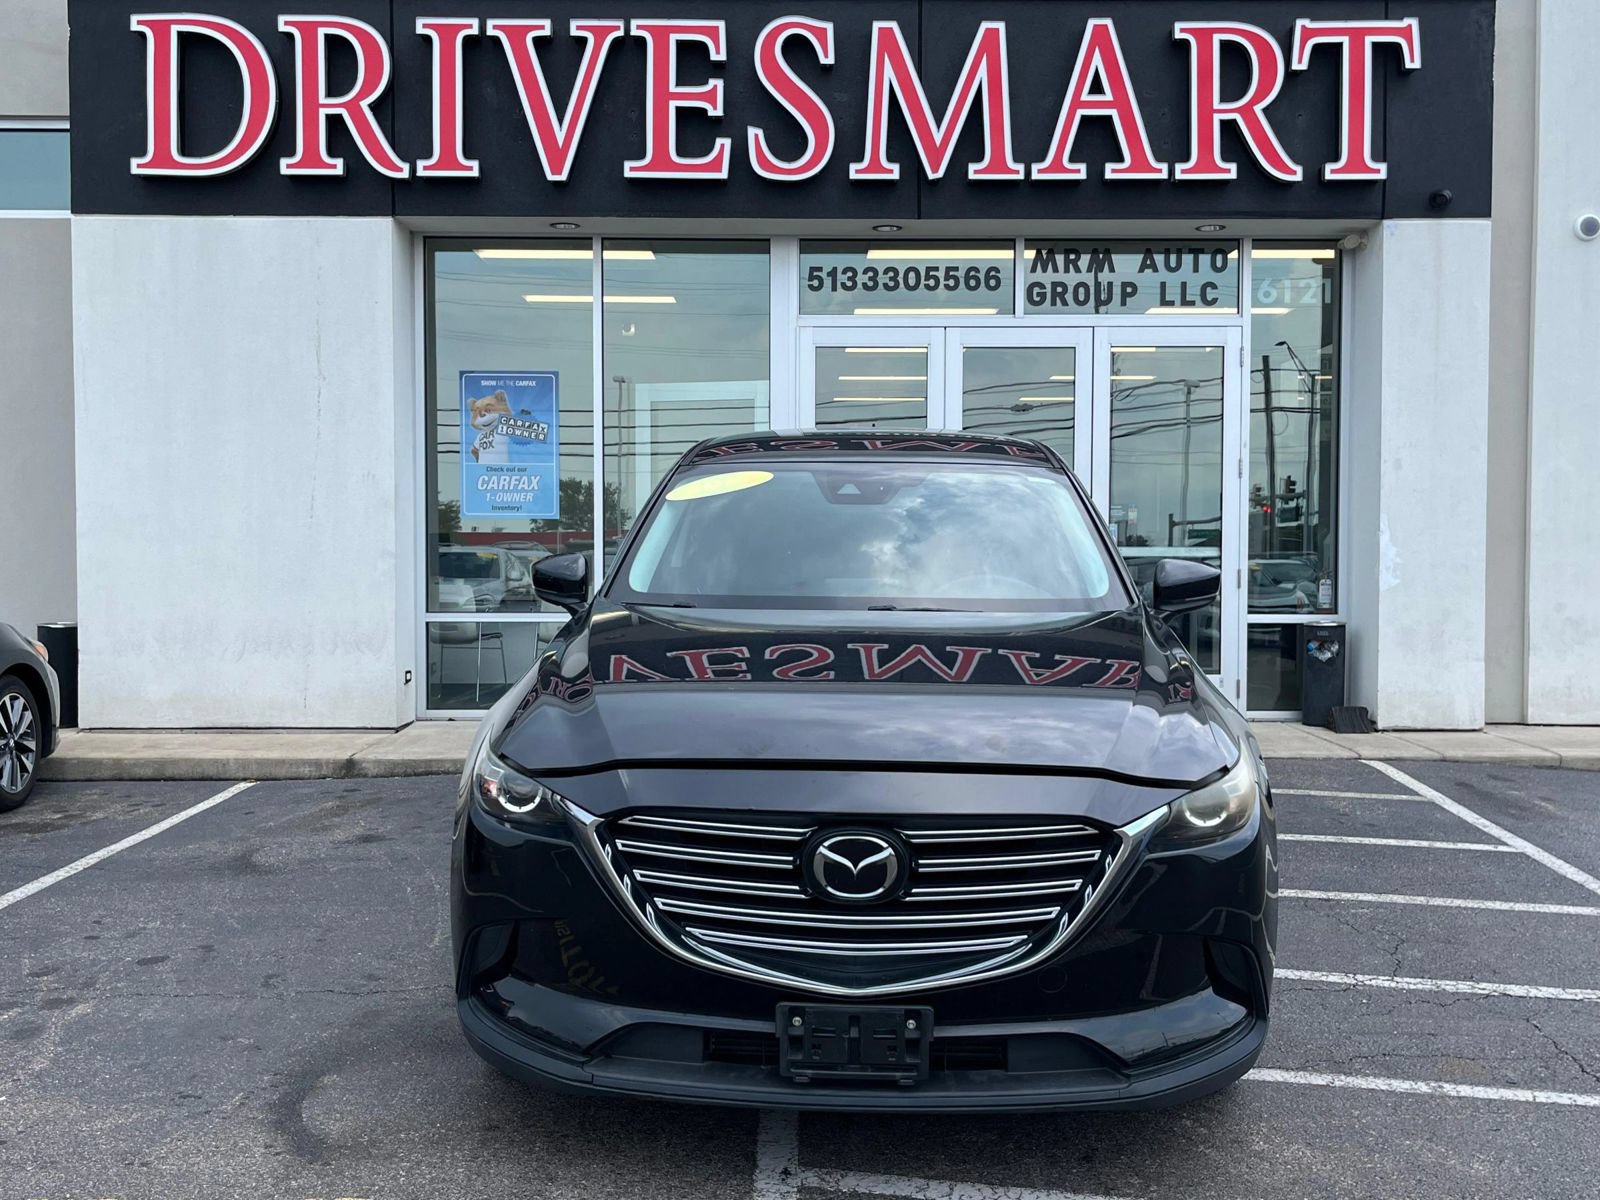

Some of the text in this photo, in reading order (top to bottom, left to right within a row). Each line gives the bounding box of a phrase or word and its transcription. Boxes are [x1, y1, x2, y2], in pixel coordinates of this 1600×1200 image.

[130, 14, 1422, 182] DRIVESMART
[1030, 248, 1229, 274] MRM AUTO
[807, 266, 1002, 292] 5133305566
[1257, 277, 1331, 304] 6121
[1026, 281, 1219, 307] GROUP LLC
[500, 416, 547, 433] CARFAX
[479, 440, 495, 450] FOX
[477, 475, 540, 490] CARFAX
[485, 492, 534, 502] 1-OWNER
